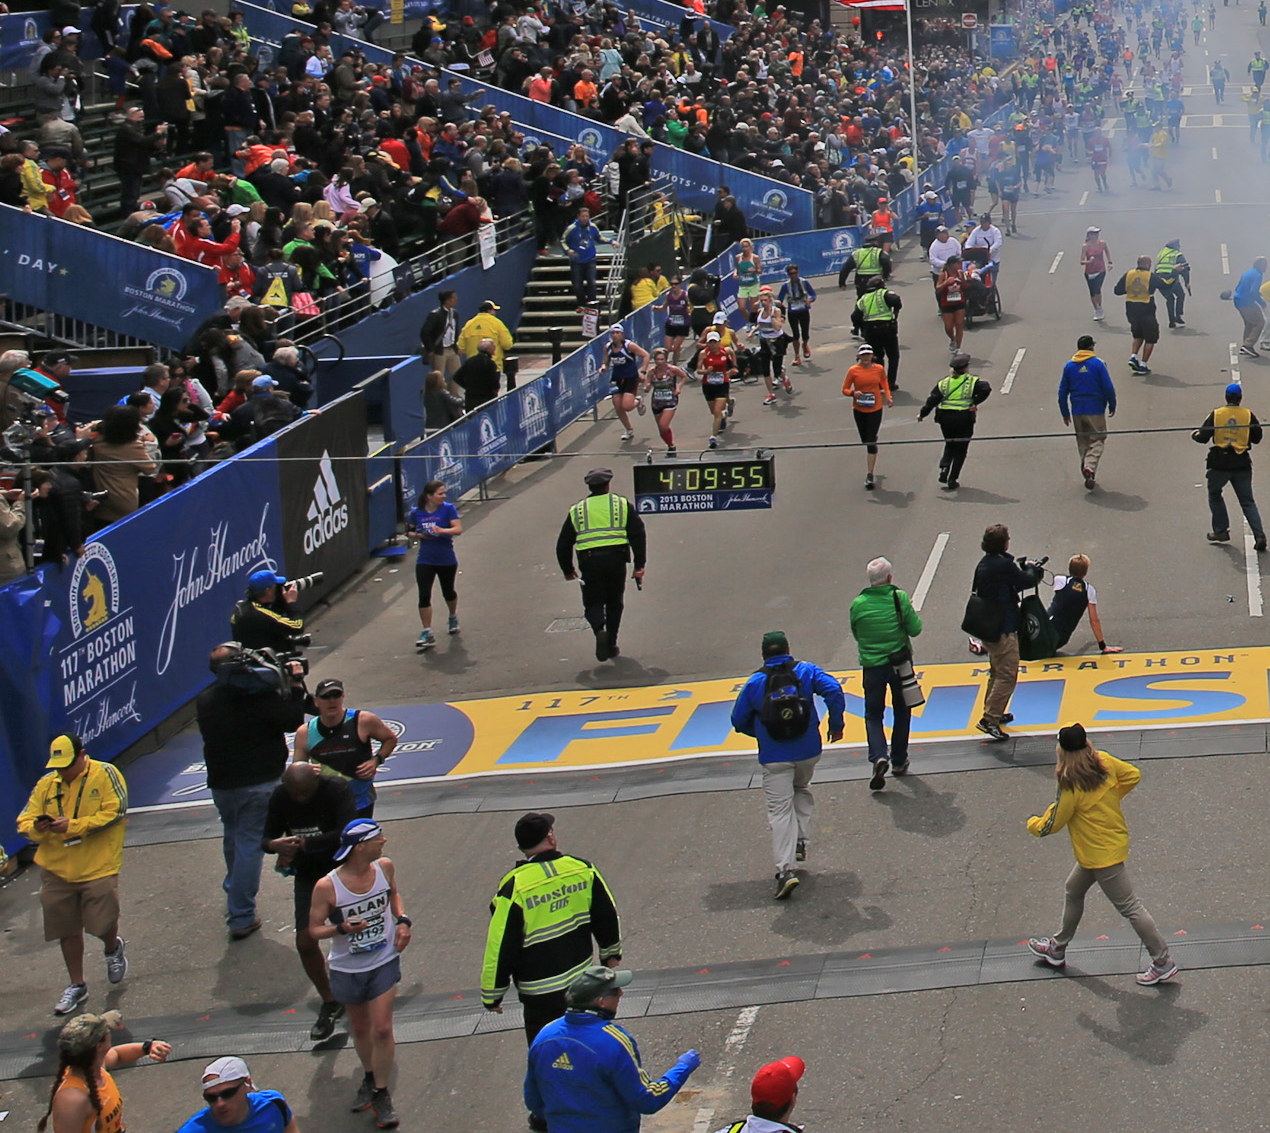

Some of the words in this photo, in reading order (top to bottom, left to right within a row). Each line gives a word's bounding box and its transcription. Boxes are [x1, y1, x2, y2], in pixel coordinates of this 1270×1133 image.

[18, 253, 59, 274] DAY
[124, 286, 154, 301] BOSTON
[154, 295, 196, 314] MARATHON
[659, 465, 763, 491] 4:09:55
[660, 494, 678, 503] 2013
[680, 493, 713, 503] BOSTON
[660, 501, 714, 512] MARATHON
[303, 504, 348, 555] adidas
[157, 547, 205, 676] John
[203, 502, 278, 591] Hancock
[87, 616, 134, 664] BOSTON
[63, 640, 136, 707] MARATHON
[347, 895, 386, 918] ALAN
[525, 880, 588, 911] Boston
[549, 895, 570, 914] EMS
[349, 924, 385, 944] 20193
